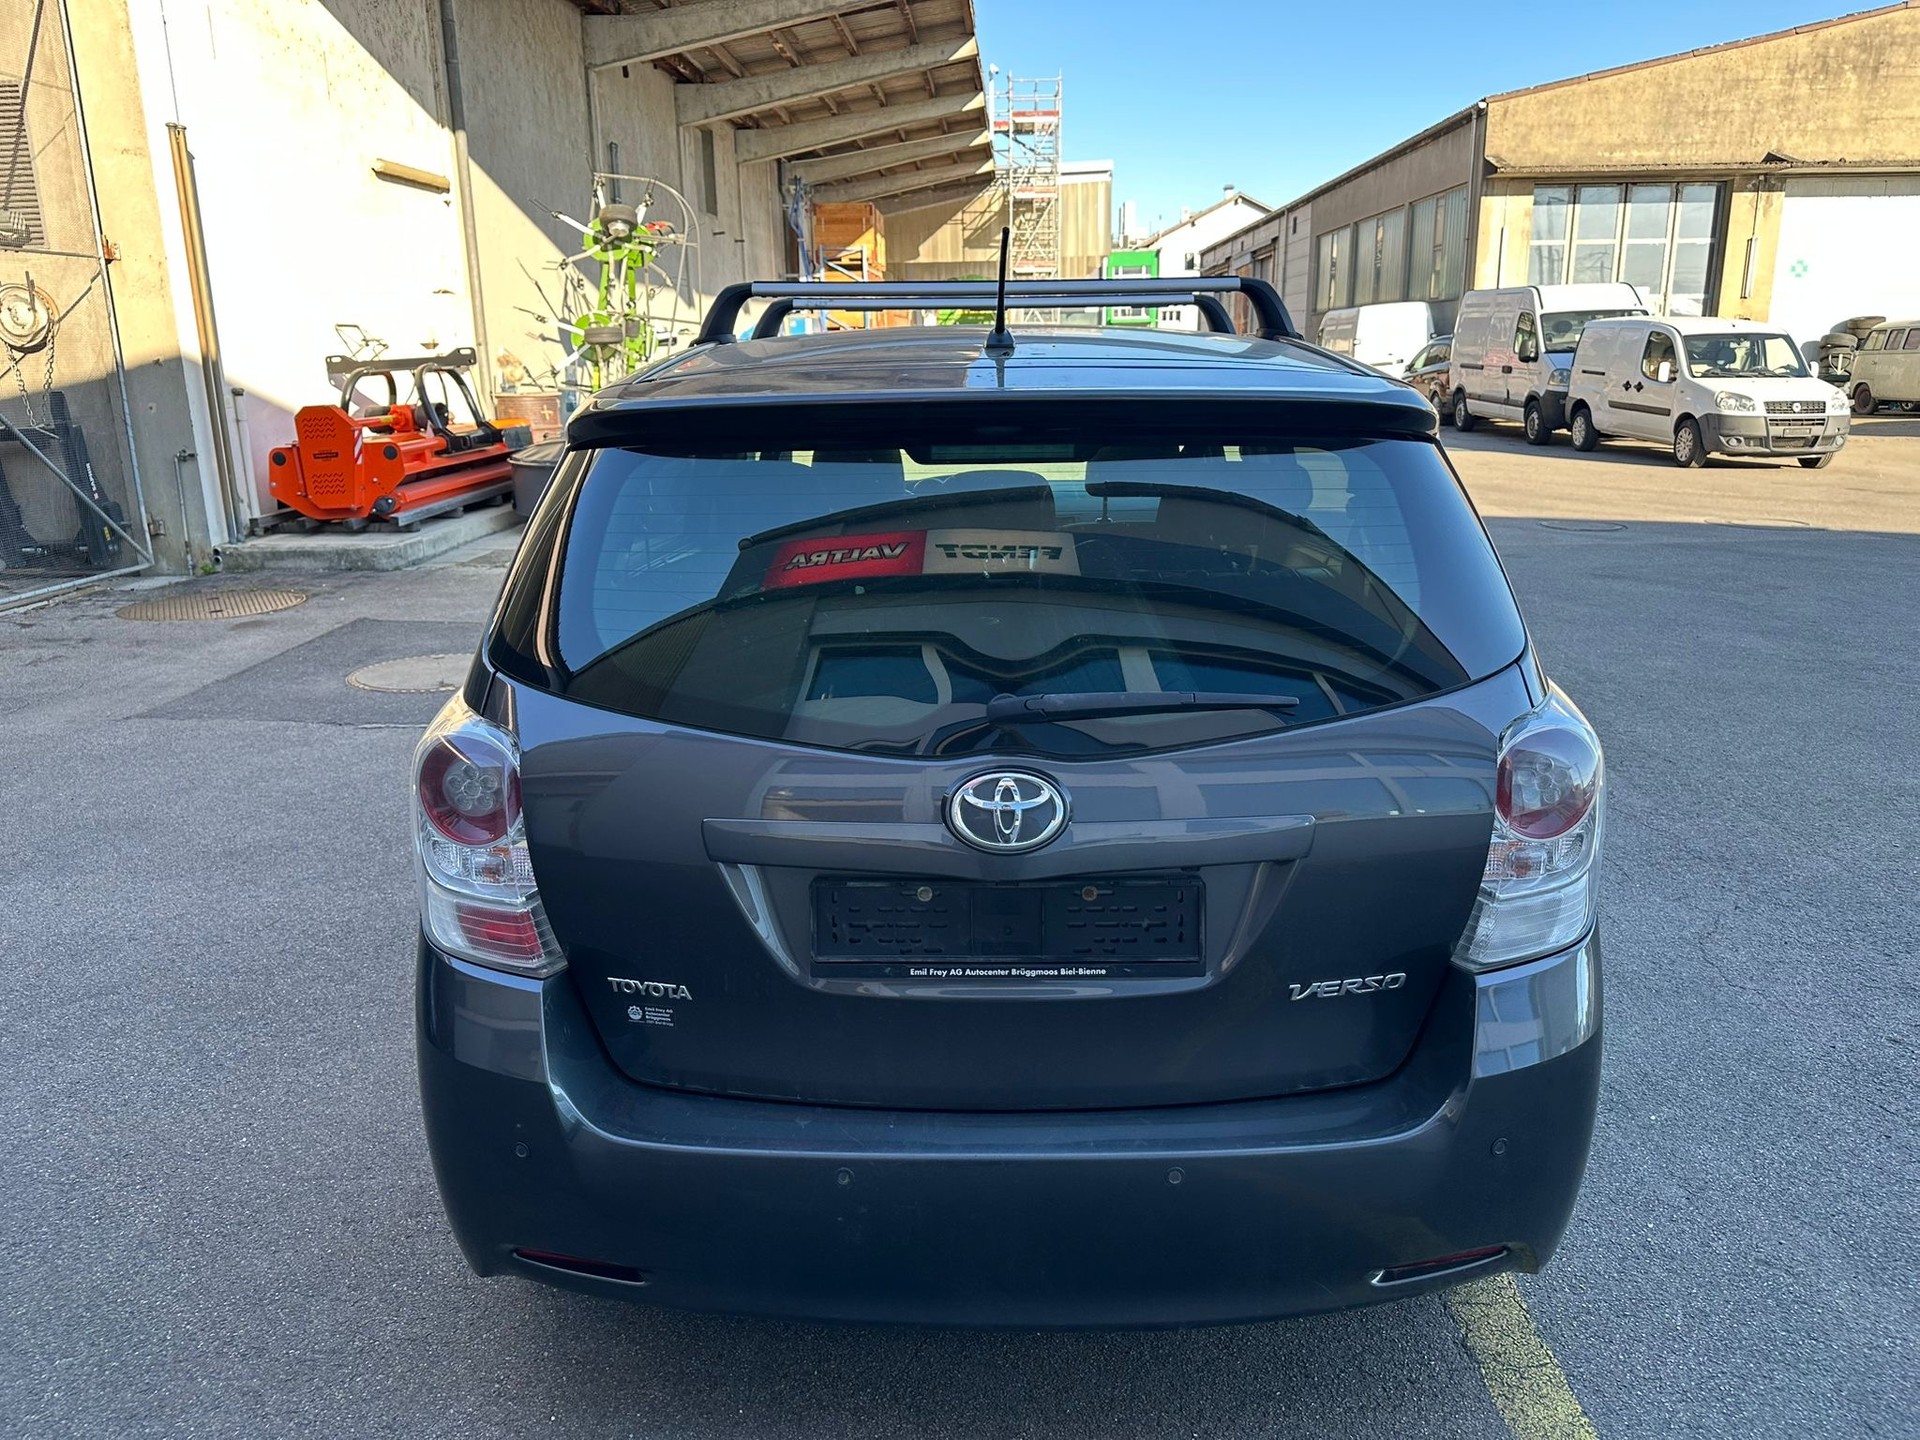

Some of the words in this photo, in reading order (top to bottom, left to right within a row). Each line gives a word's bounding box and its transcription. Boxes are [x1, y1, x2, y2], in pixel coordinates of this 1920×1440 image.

[910, 968, 928, 976] Emil
[929, 968, 948, 978] Frey
[949, 968, 963, 976] AG
[964, 968, 1010, 976] Autocenter
[1011, 967, 1058, 978] Brüggmoos
[1060, 967, 1107, 976] Biel-Bienne
[607, 977, 693, 1001] TOYOTA
[1288, 972, 1407, 1001] VERSO
